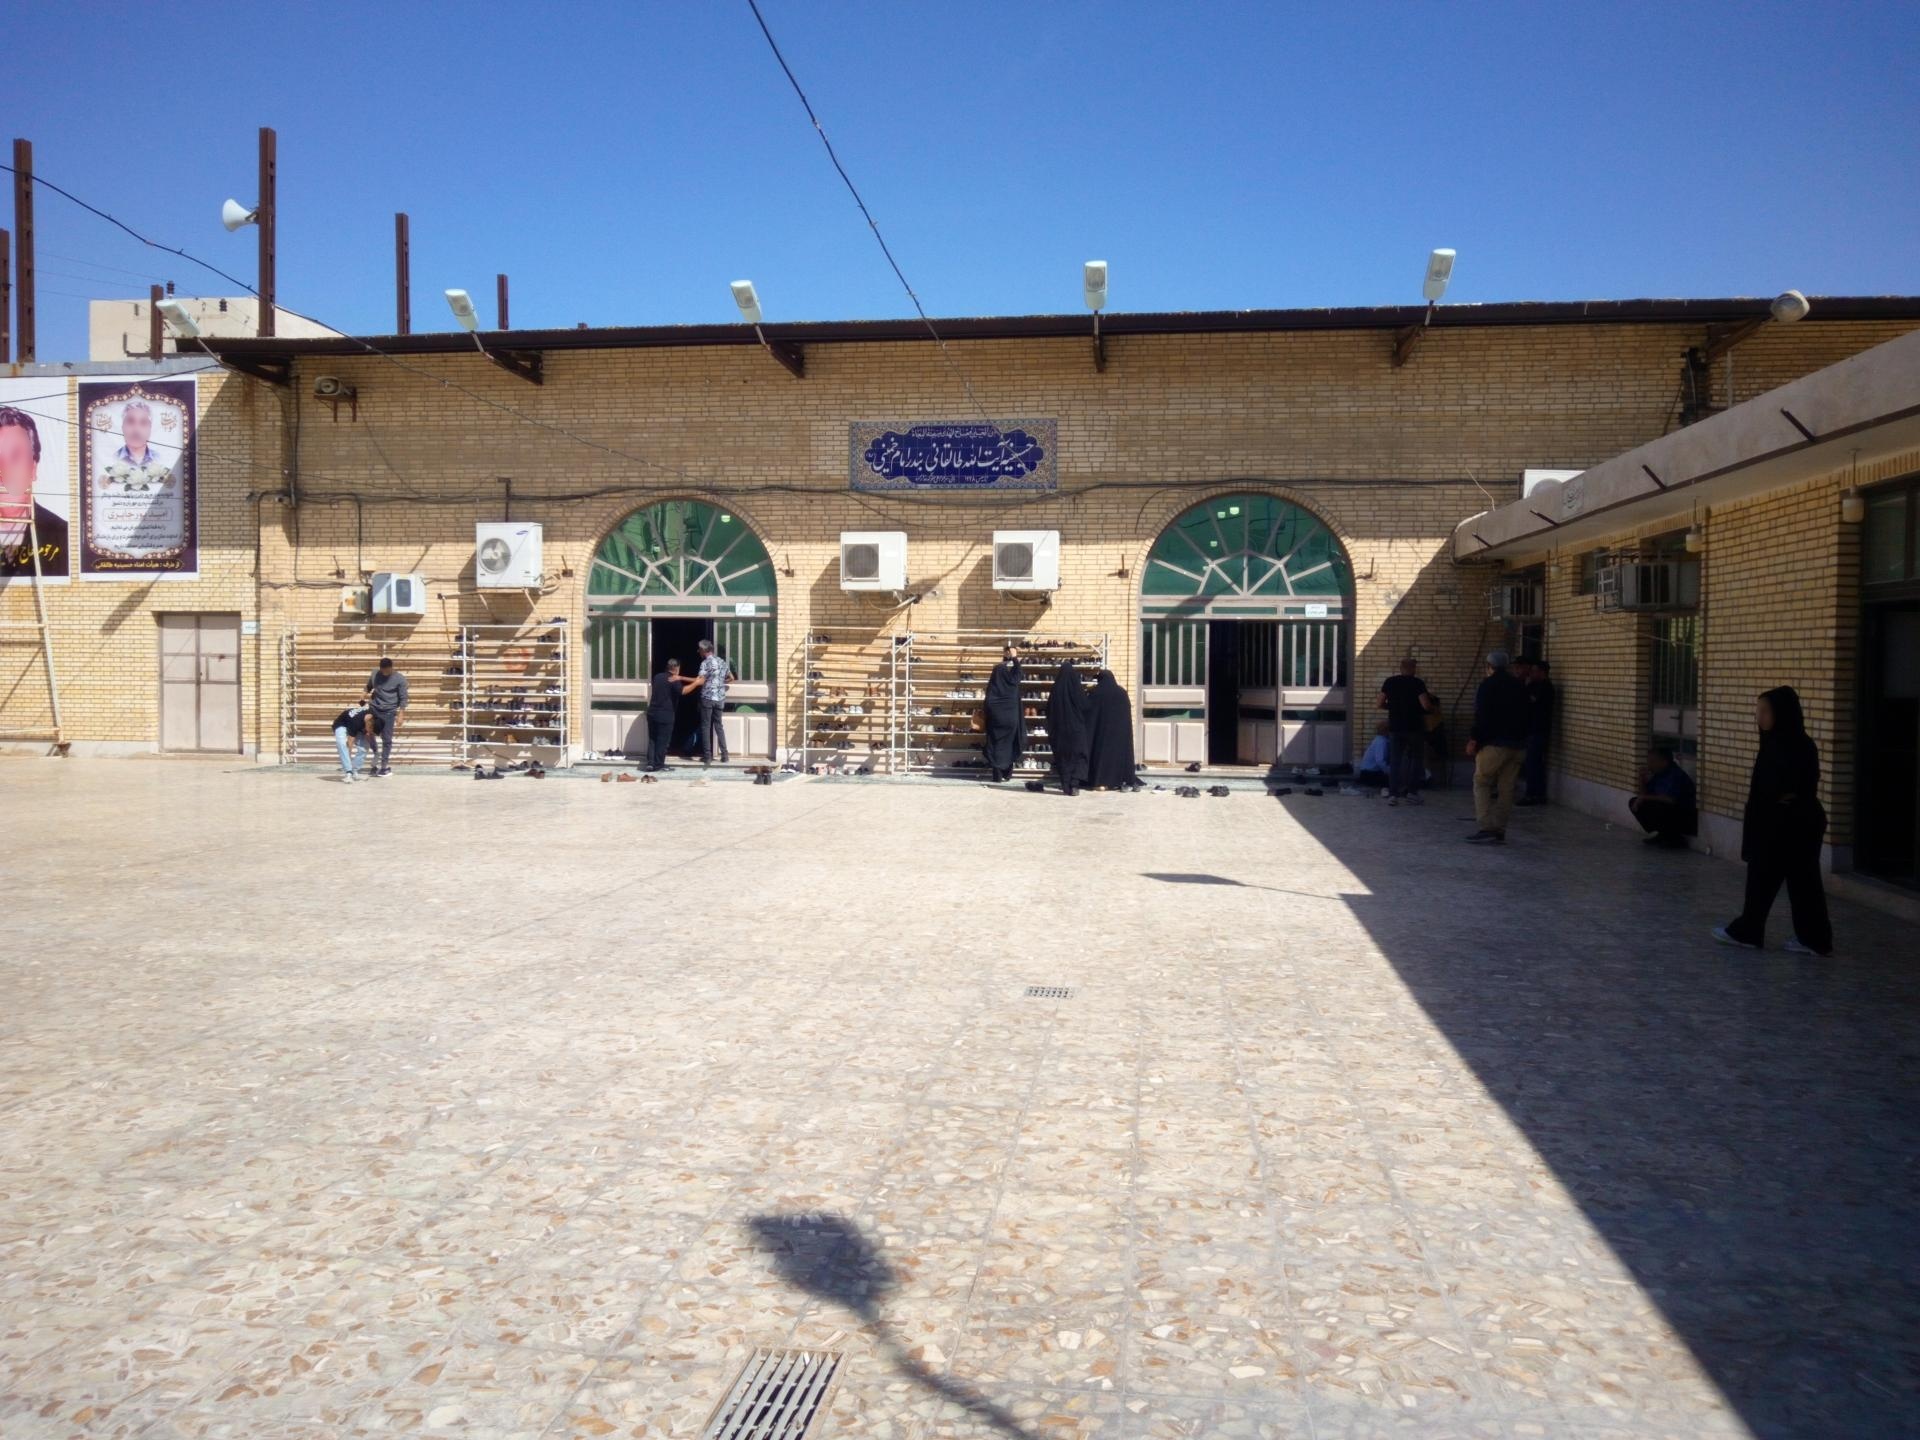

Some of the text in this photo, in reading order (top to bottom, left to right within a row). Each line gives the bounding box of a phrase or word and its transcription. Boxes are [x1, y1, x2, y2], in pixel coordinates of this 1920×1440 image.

[872, 436, 899, 473] خمینی
[891, 447, 911, 473] امام
[904, 452, 924, 471] بندر
[925, 442, 963, 472] طالقانی
[962, 444, 982, 469] الله
[1000, 443, 1035, 471] حسینیه
[114, 561, 133, 569] حسینیه
